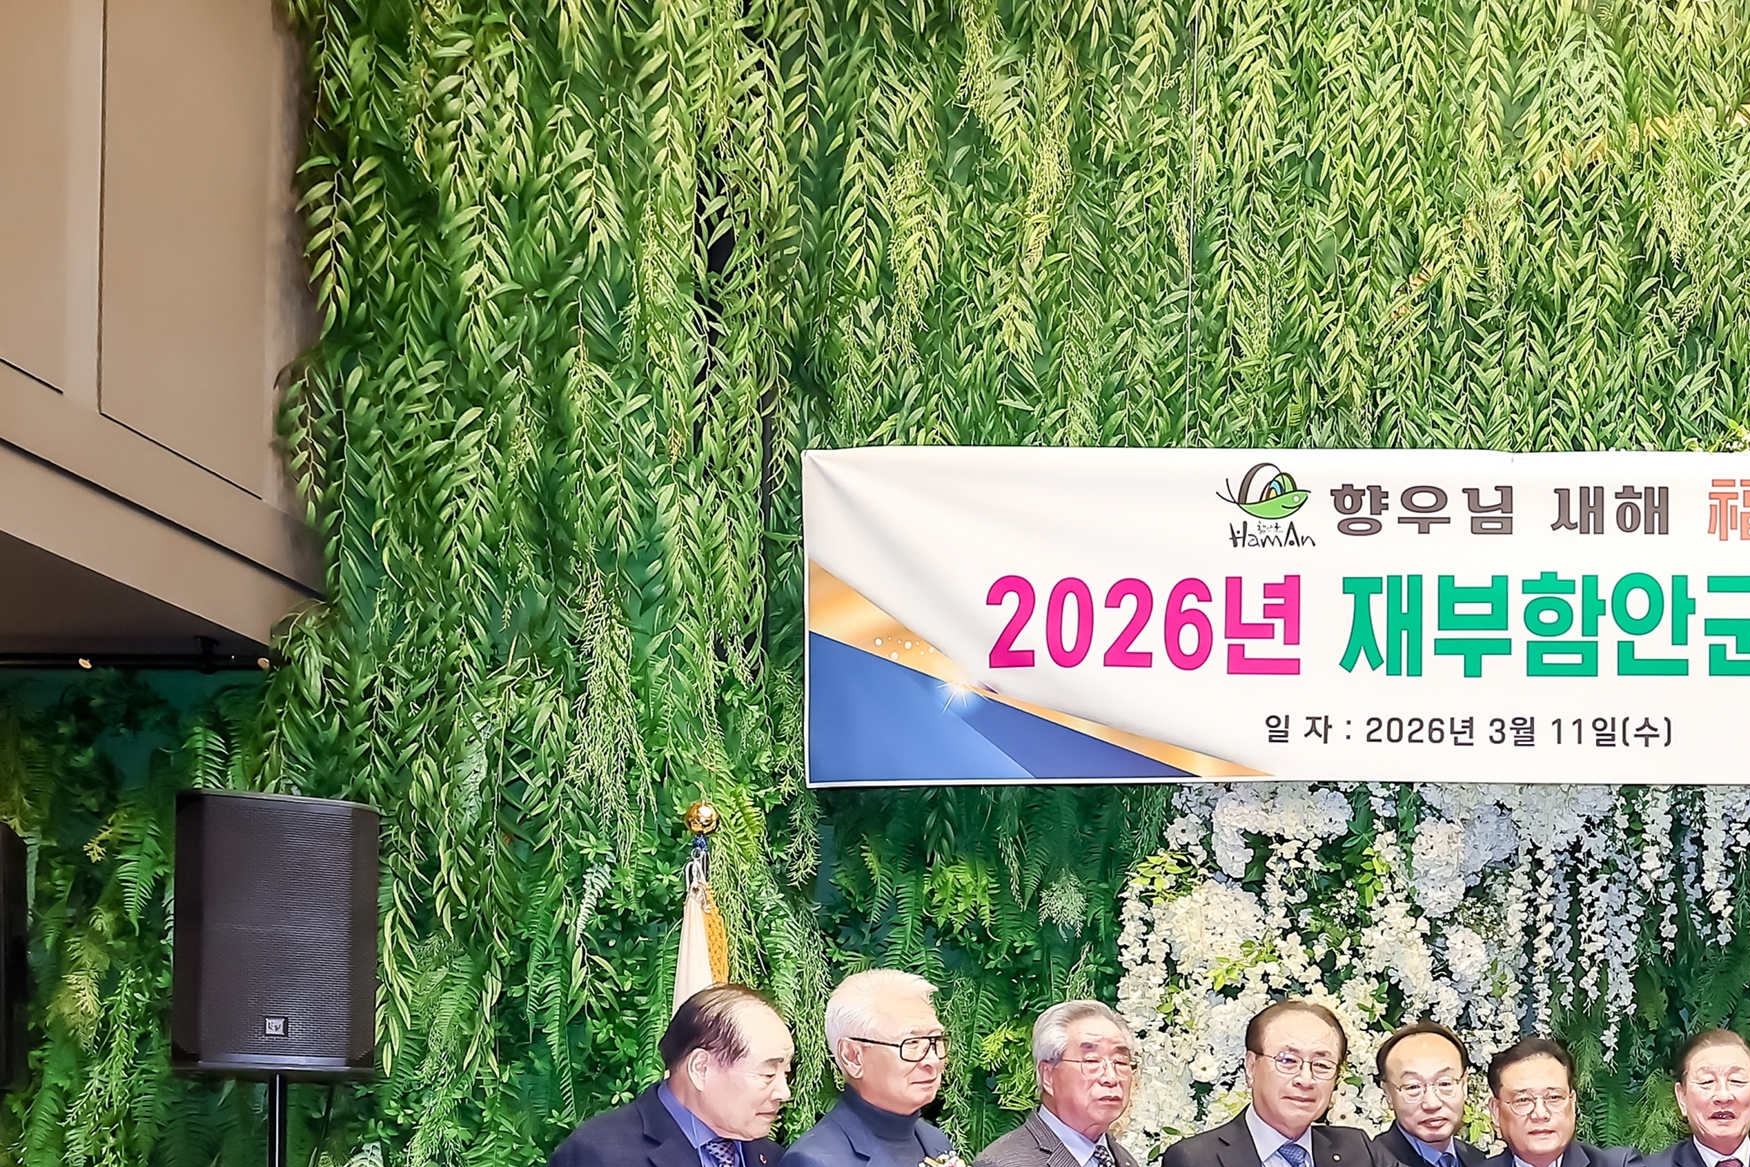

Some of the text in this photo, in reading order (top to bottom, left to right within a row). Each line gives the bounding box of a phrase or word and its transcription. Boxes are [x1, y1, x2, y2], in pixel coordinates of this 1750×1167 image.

[1329, 483, 1514, 537] 향우님
[1550, 485, 1669, 535] 새해
[1229, 520, 1317, 549] HamAn
[985, 574, 1301, 676] 2026년
[1366, 716, 1474, 747] 2026년
[1488, 716, 1535, 747] 3월
[1551, 716, 1672, 748] 11일(수)
